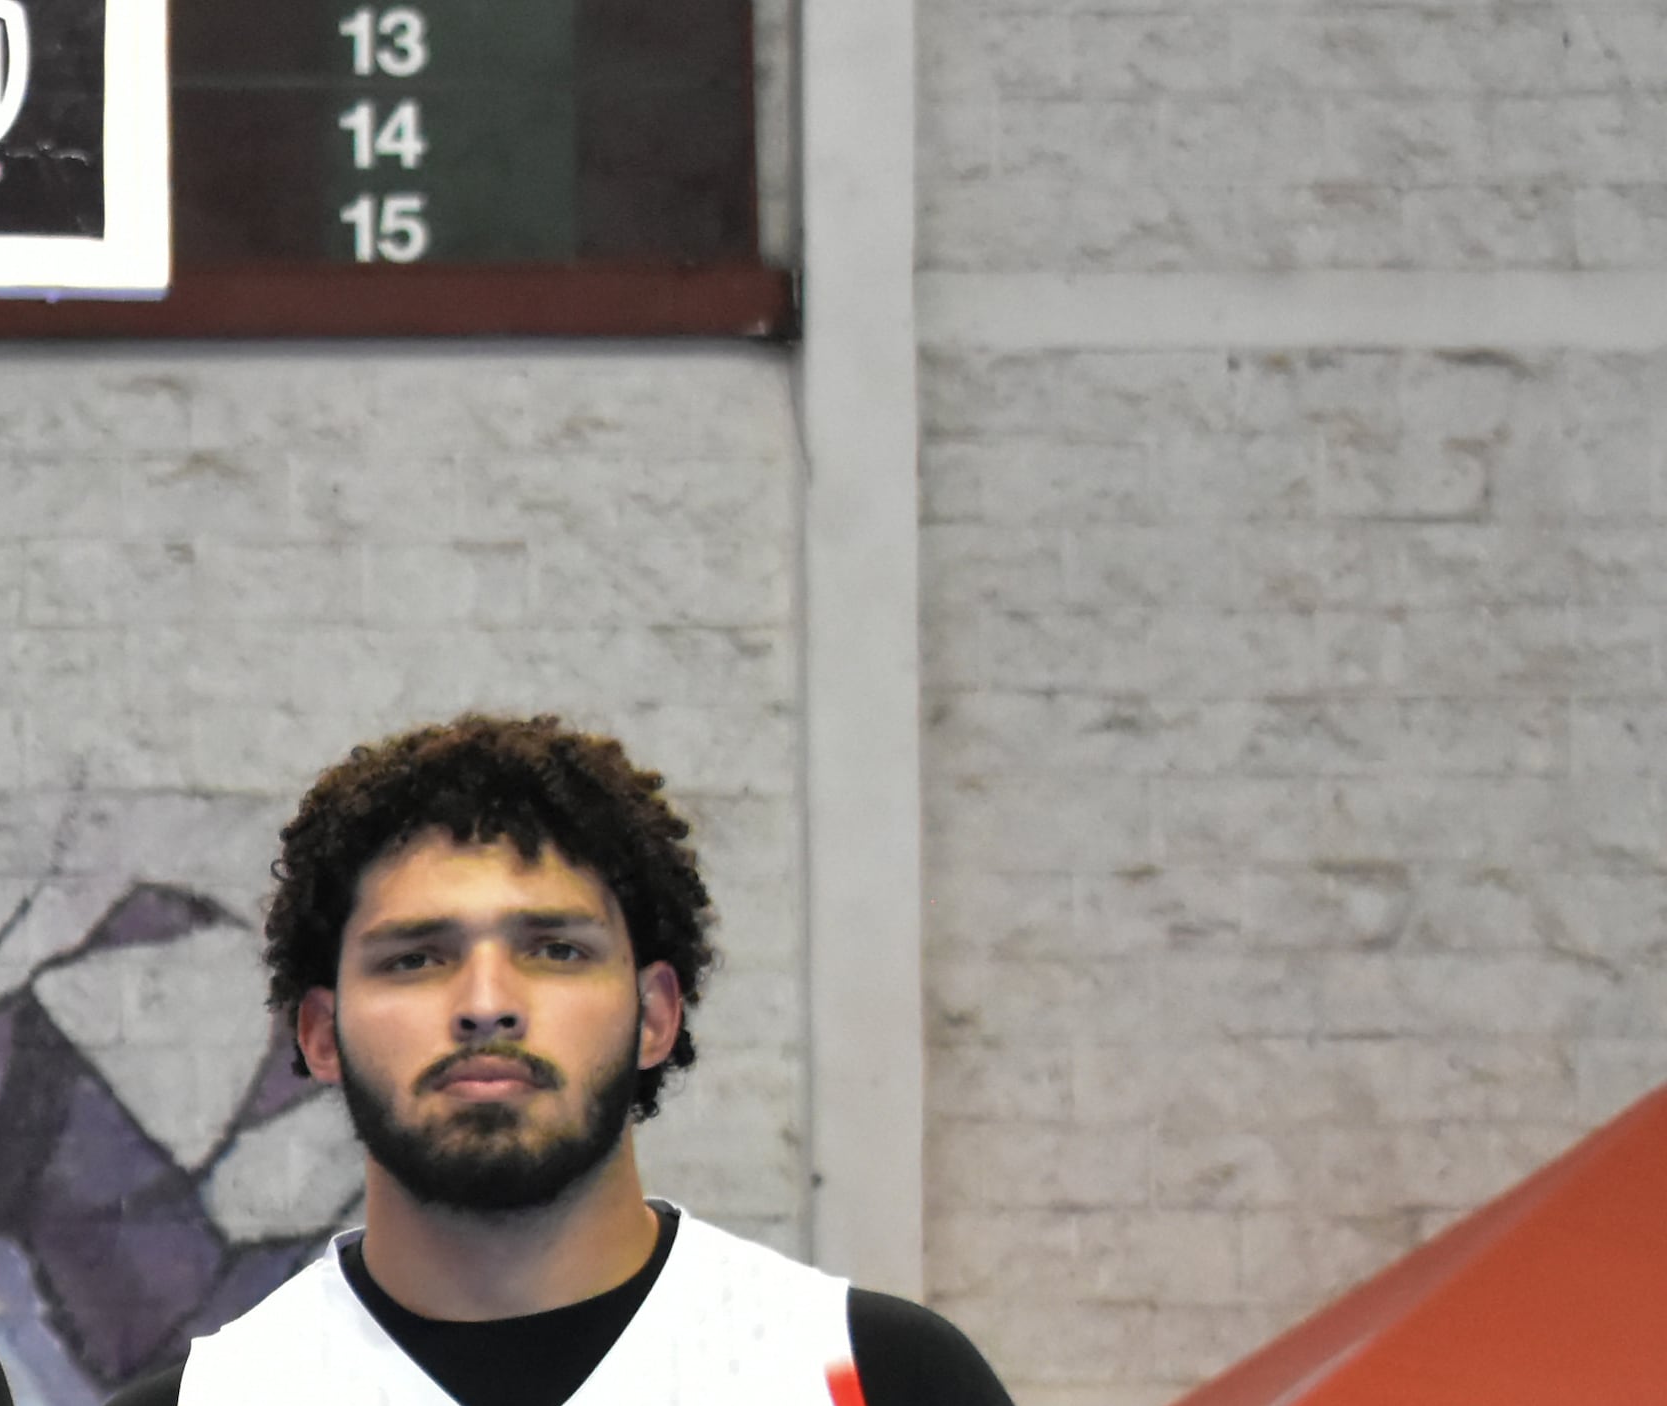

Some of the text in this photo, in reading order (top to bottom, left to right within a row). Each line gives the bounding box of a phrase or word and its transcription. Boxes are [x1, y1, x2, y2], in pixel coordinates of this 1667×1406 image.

[339, 9, 428, 76] 13
[338, 99, 428, 169] 14
[339, 194, 429, 263] 15
